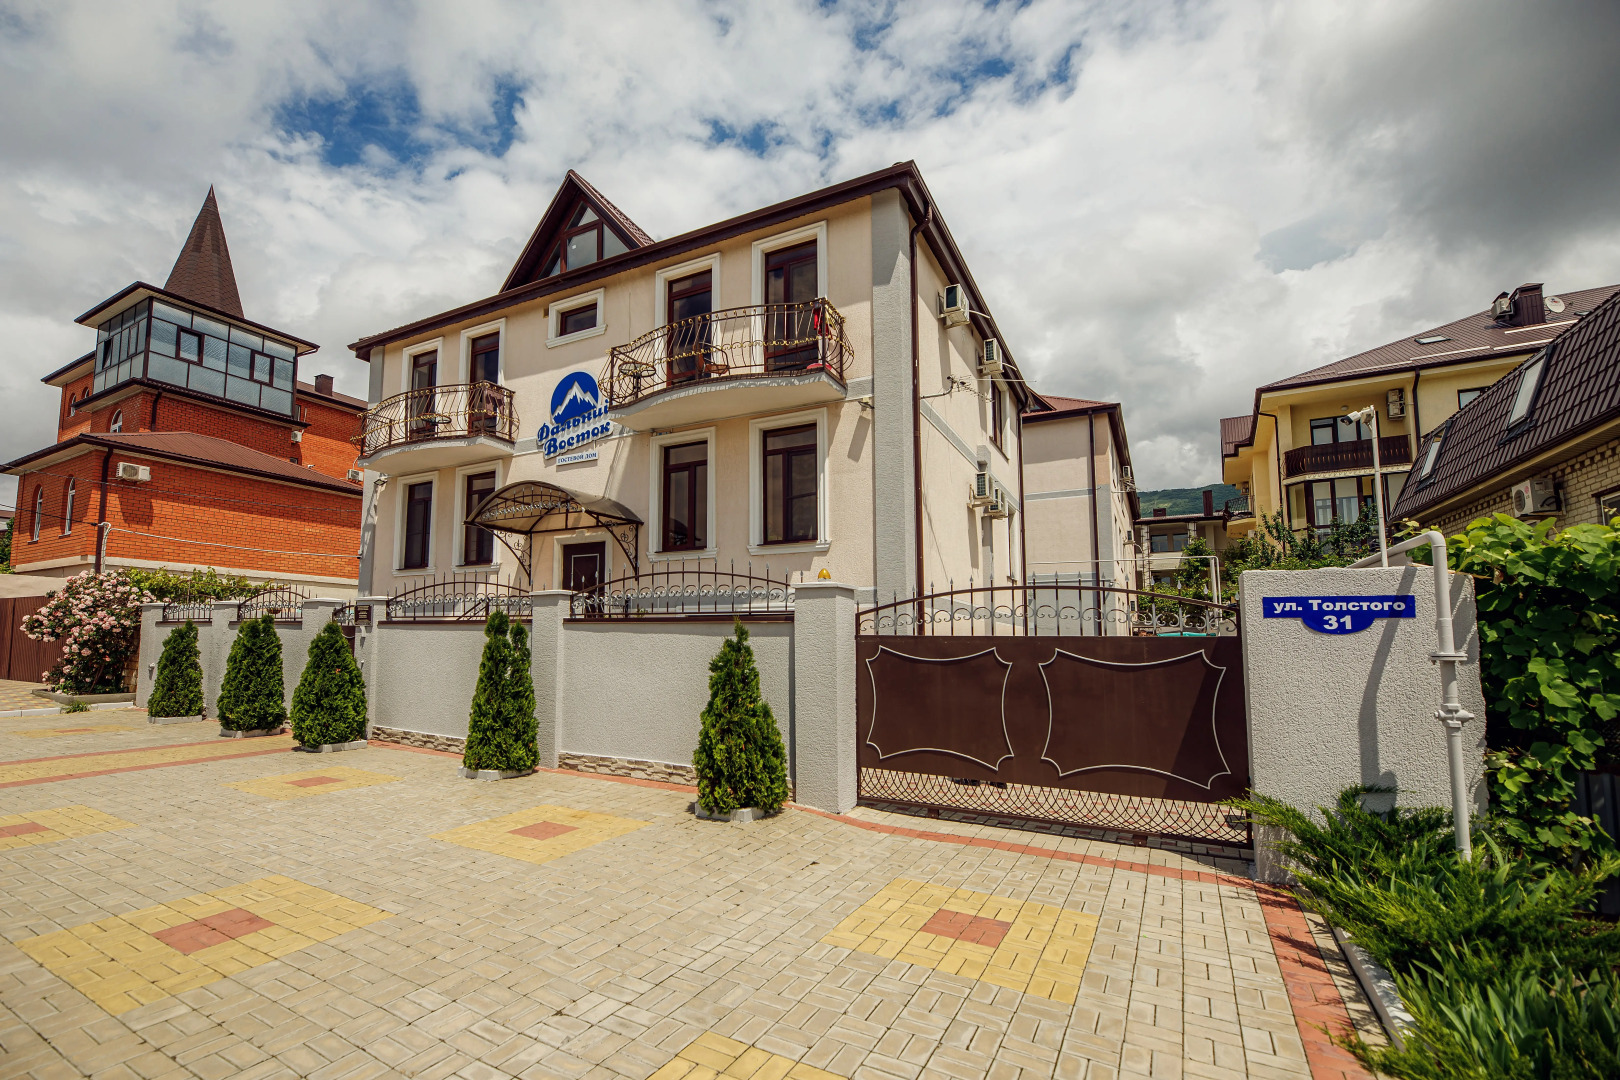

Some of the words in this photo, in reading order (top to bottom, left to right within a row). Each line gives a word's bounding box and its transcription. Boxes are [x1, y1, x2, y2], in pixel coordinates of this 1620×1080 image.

[544, 421, 611, 456] Восток
[1273, 602, 1303, 614] ул.
[1308, 599, 1406, 611] Толстого
[1323, 615, 1352, 630] 31
